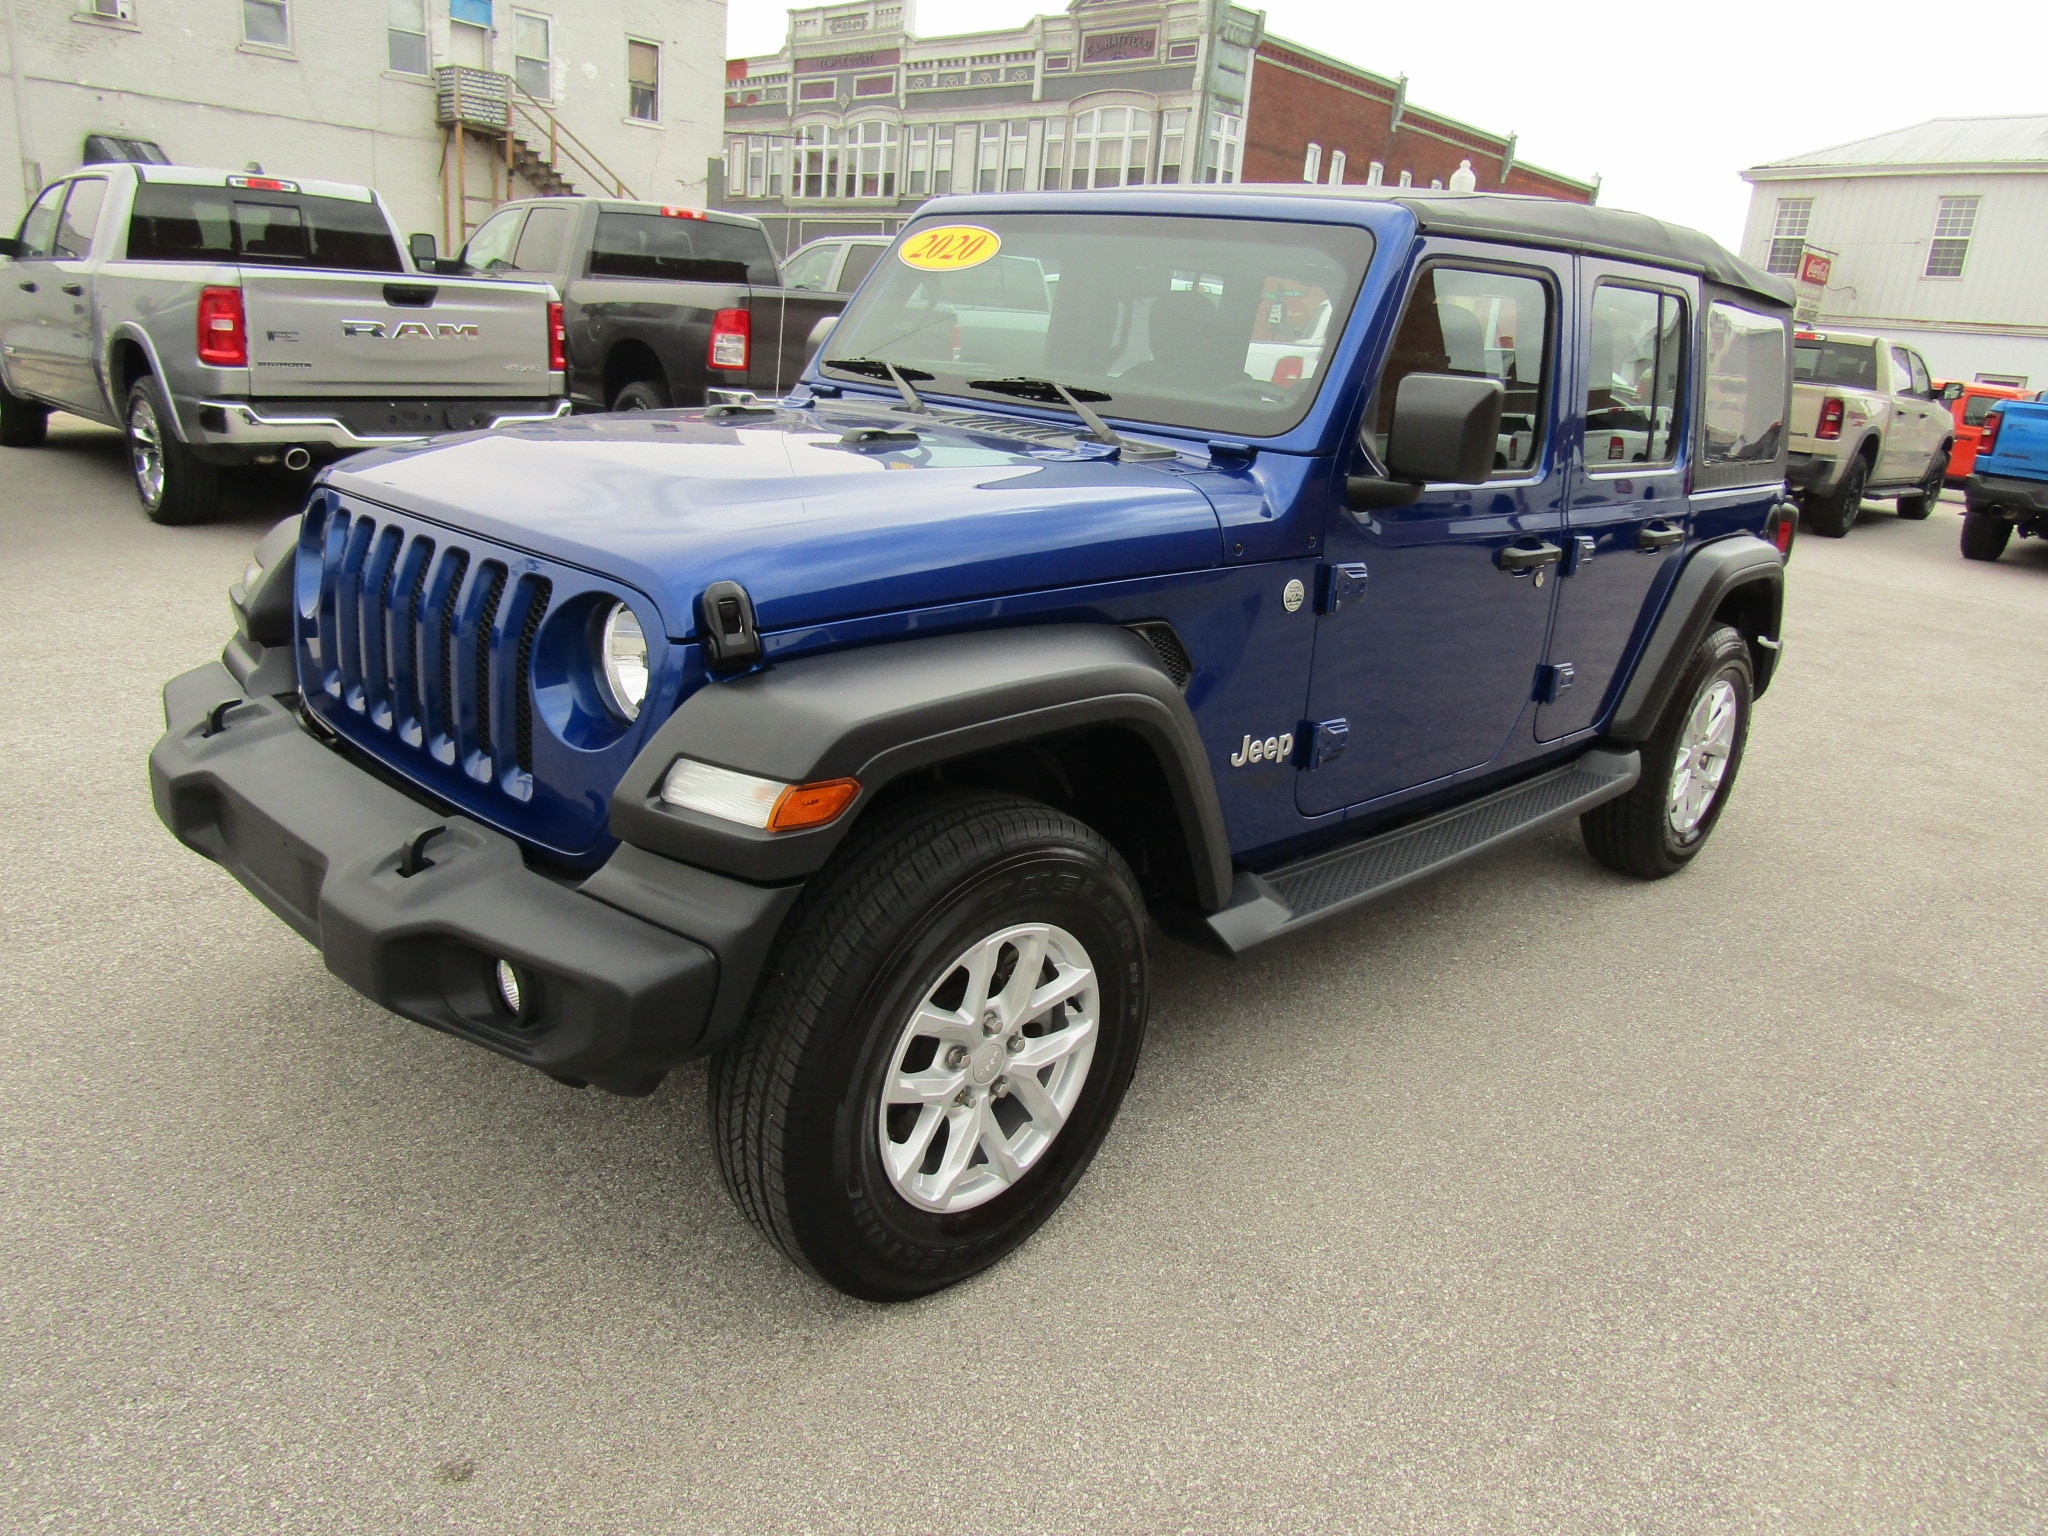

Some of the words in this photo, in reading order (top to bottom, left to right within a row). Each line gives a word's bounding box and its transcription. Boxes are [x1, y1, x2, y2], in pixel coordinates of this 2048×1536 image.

[908, 234, 987, 260] 2020
[341, 319, 479, 341] RAM
[1230, 732, 1294, 768] Jeep
